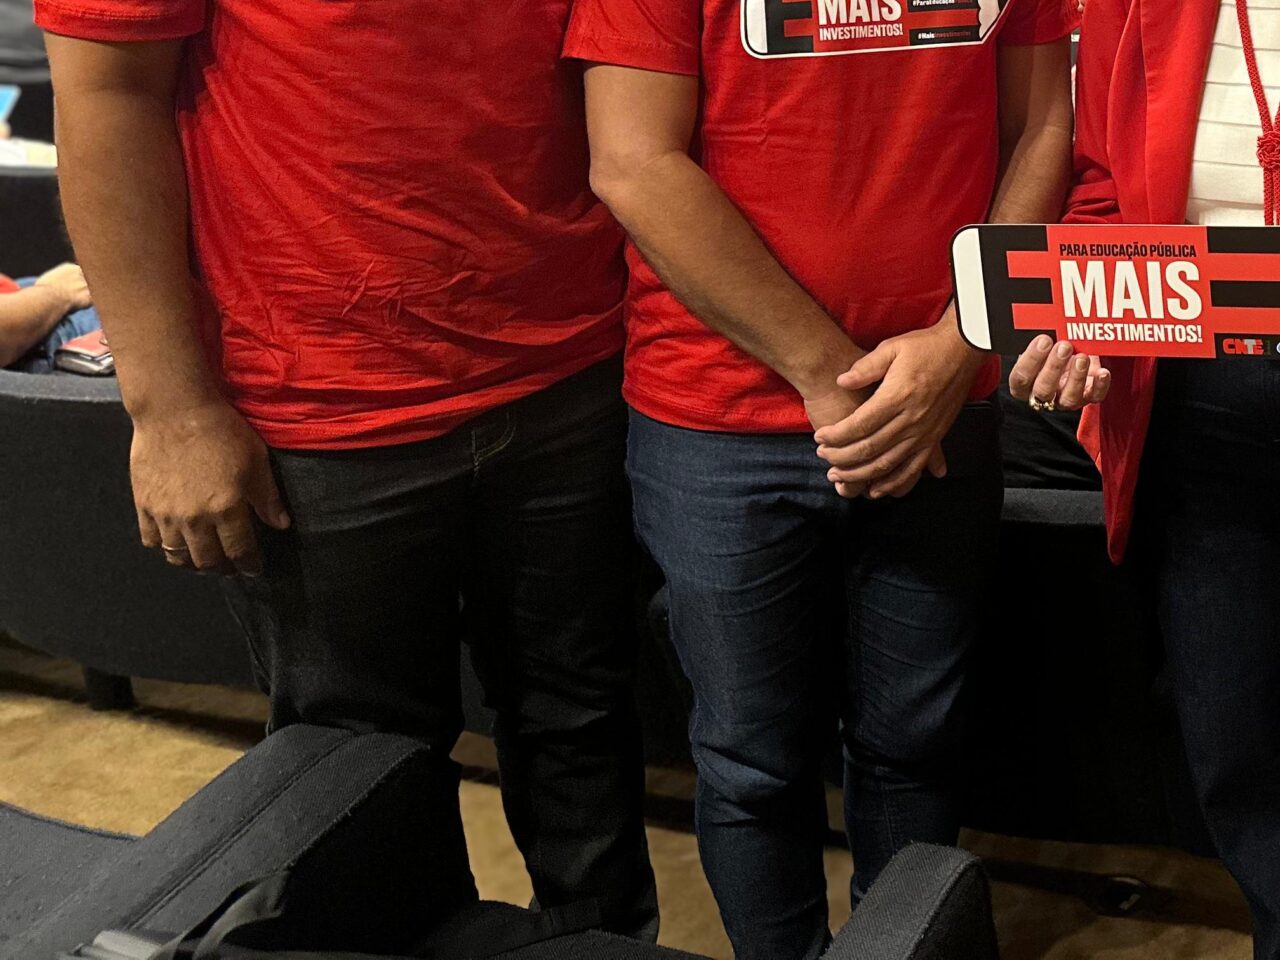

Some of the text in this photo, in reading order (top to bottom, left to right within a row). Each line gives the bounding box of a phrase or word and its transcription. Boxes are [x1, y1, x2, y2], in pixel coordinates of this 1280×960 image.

[820, 24, 903, 40] INVESTIMENTOS!
[1060, 242, 1196, 259] PARA EDUCAÇÃO PÚBLICA
[1060, 260, 1202, 320] MAIS
[1066, 323, 1202, 342] INVESTIMENTOS!
